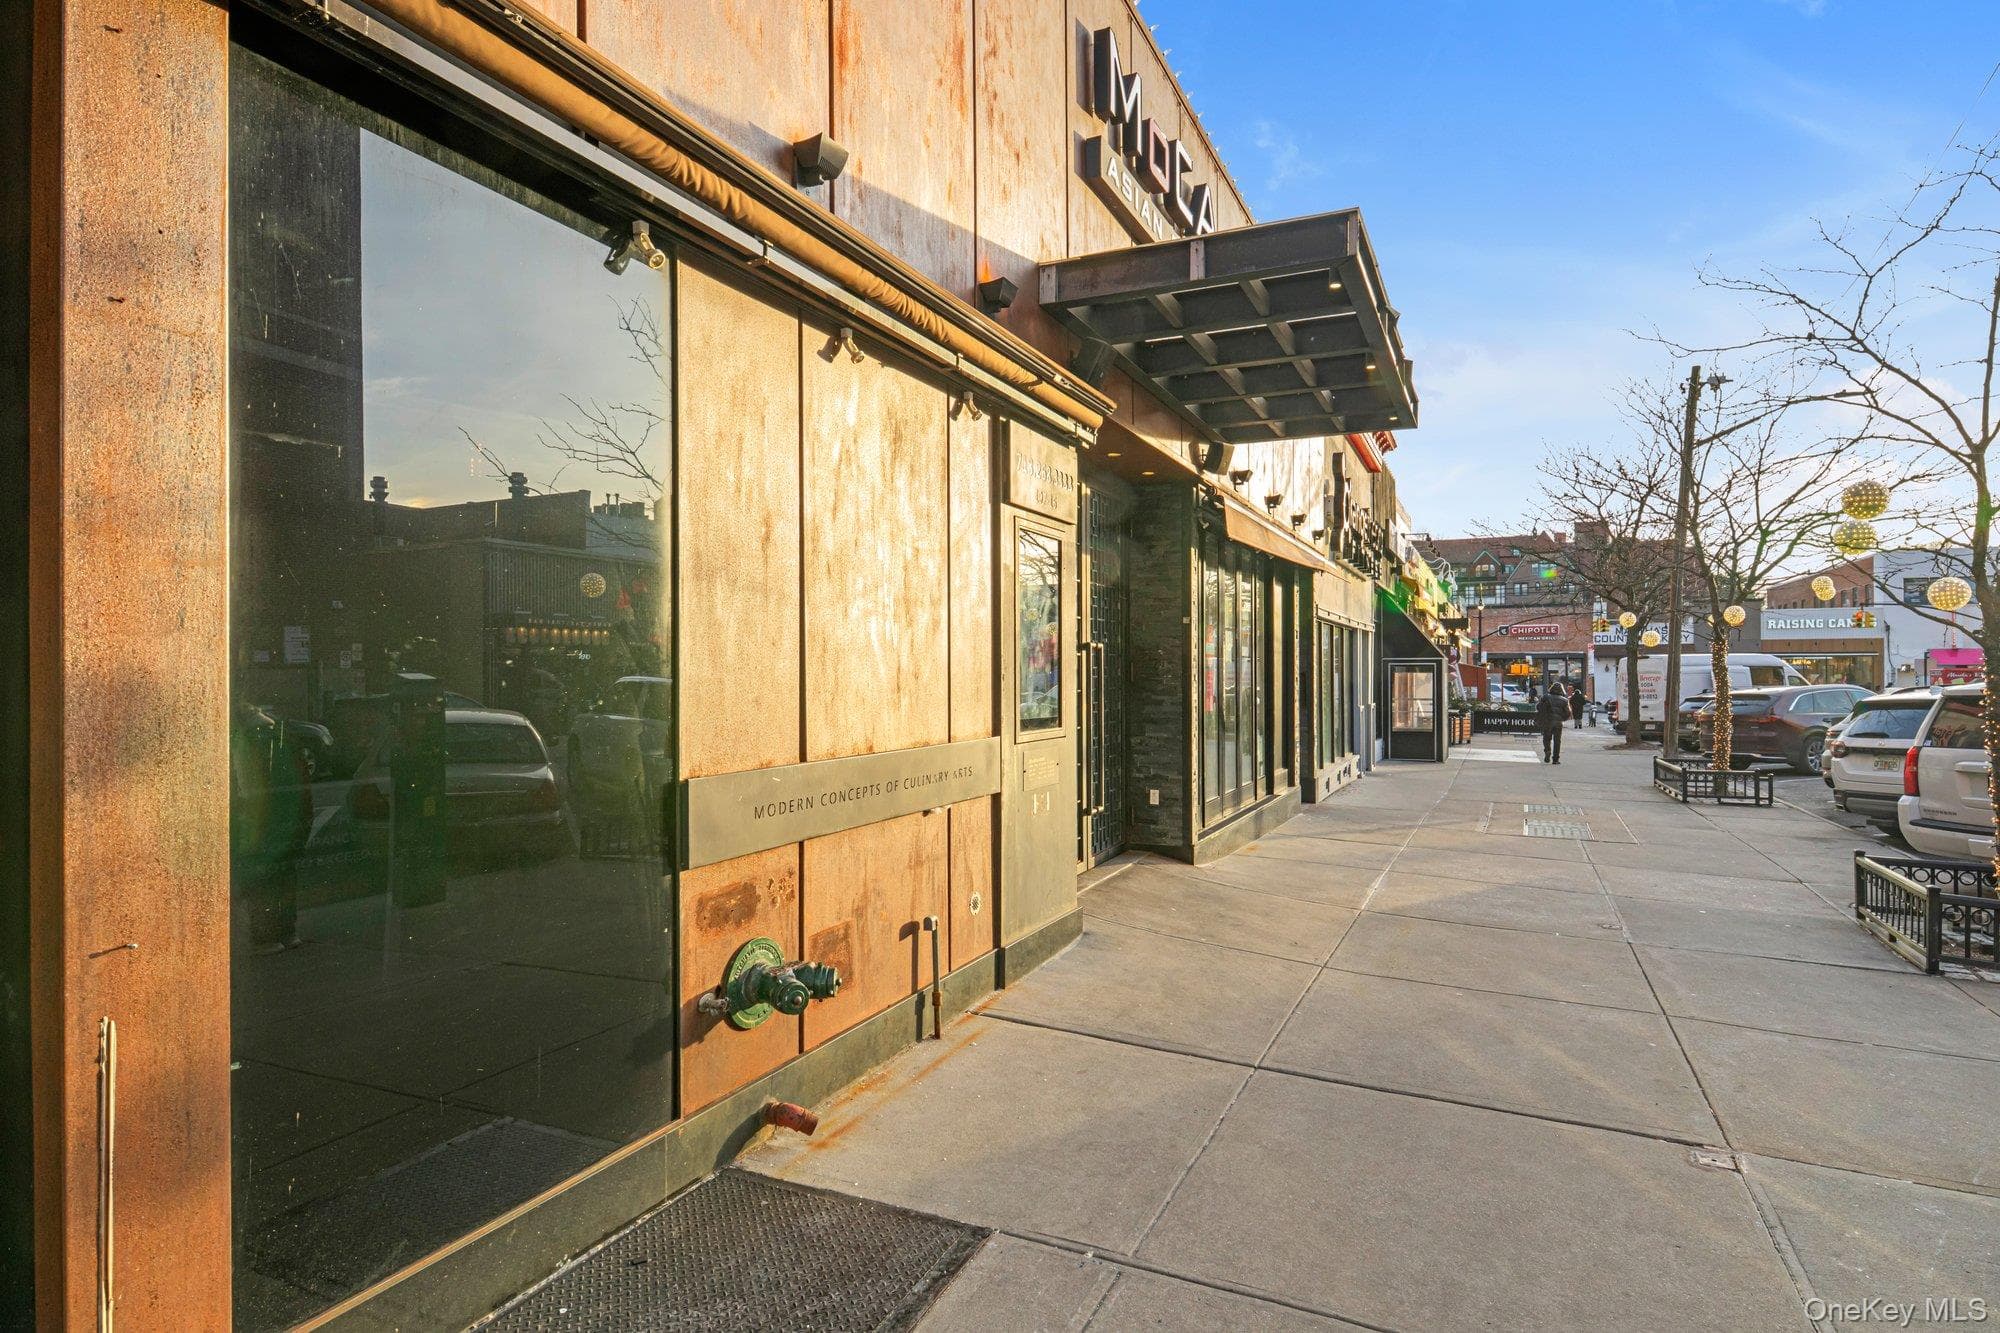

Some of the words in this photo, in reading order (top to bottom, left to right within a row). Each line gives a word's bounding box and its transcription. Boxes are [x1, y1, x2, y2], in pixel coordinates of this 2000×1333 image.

[1095, 28, 1215, 236] MOCA
[1107, 156, 1163, 239] ASIAN
[1511, 626, 1556, 634] CHIPOTLE
[1767, 619, 1823, 629] RAISING
[1511, 718, 1535, 726] HOUR
[754, 796, 814, 820] MODERN
[820, 784, 881, 807] CONCEPTS
[886, 780, 899, 793] OF
[903, 770, 949, 790] CULINARY
[952, 766, 974, 780] ARTS
